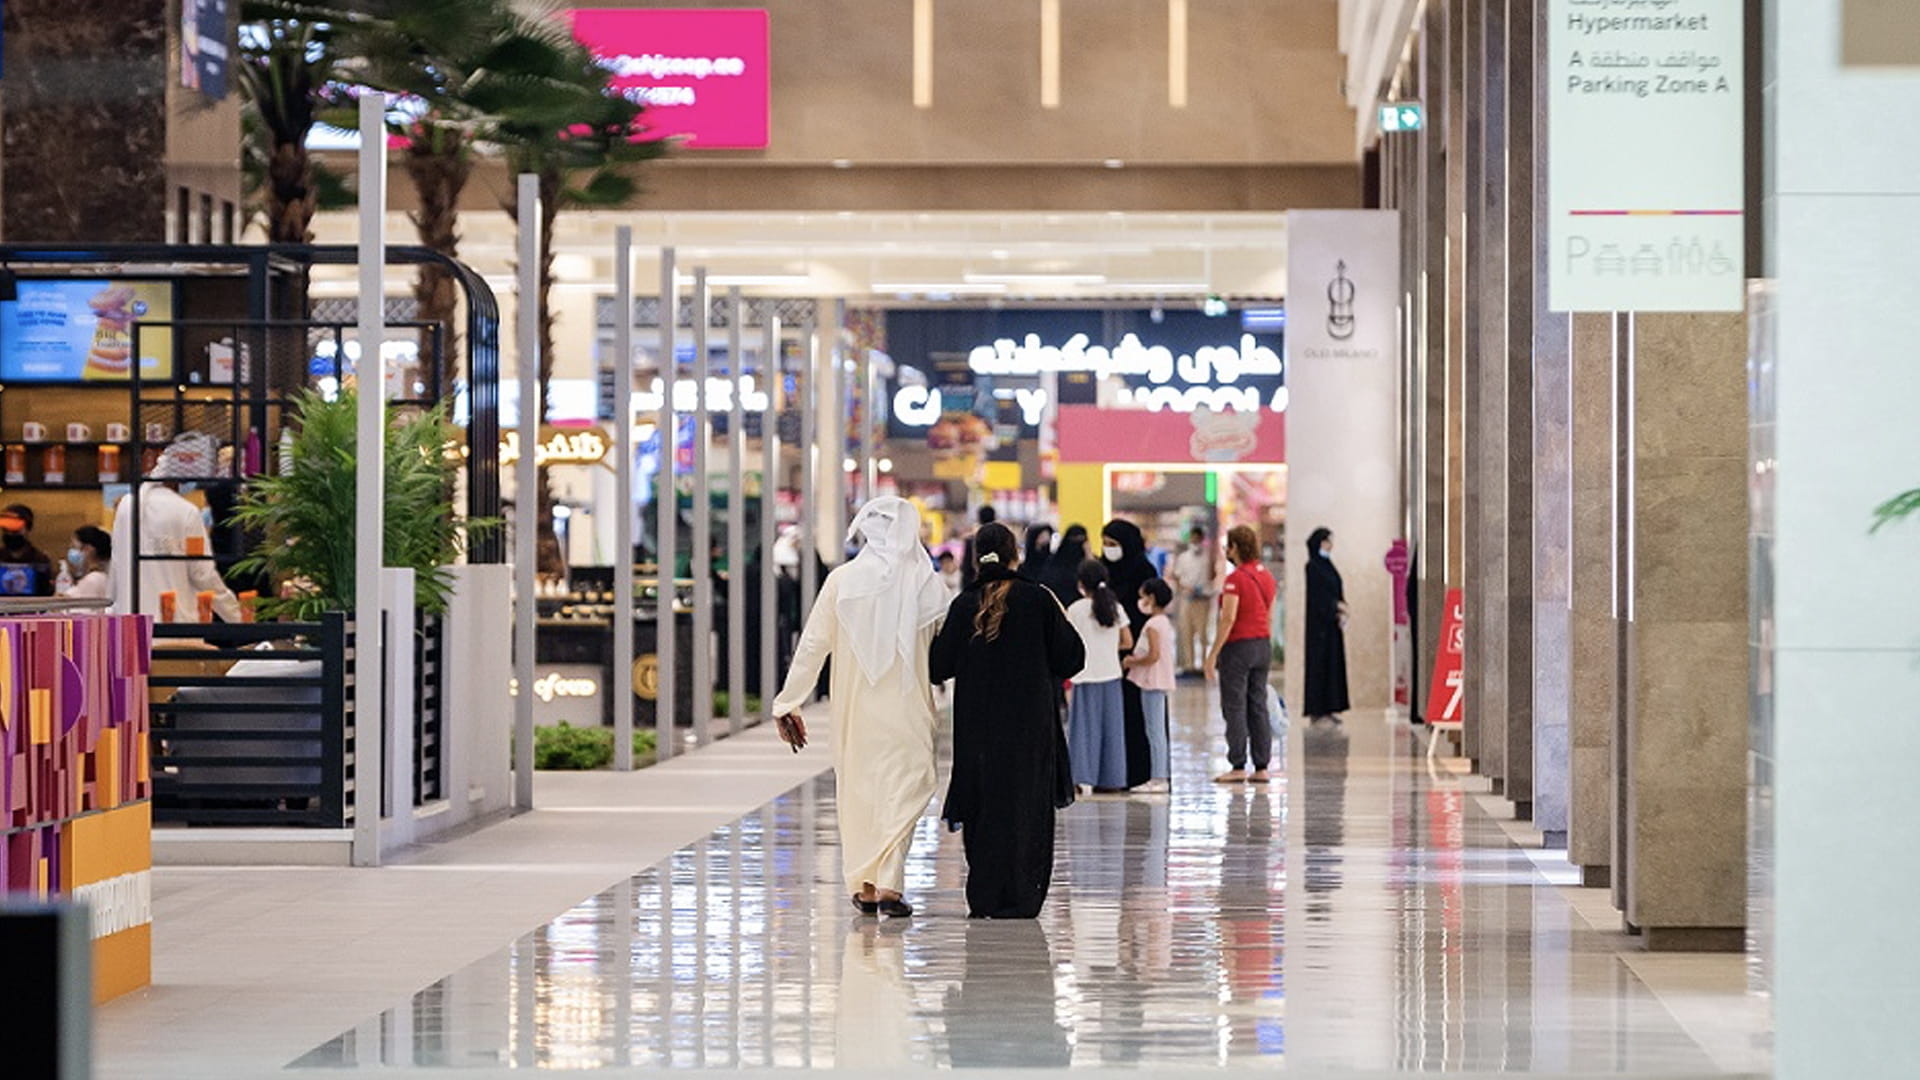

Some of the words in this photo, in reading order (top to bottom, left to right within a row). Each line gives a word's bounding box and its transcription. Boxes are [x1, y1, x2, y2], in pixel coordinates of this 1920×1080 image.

[1567, 12, 1709, 35] Hypermarket
[1569, 50, 1584, 68] A
[1589, 51, 1649, 68] منطقة
[1656, 50, 1722, 72] مواقف
[1567, 74, 1649, 98] Parking
[1654, 74, 1708, 94] Zone
[1714, 75, 1731, 93] A
